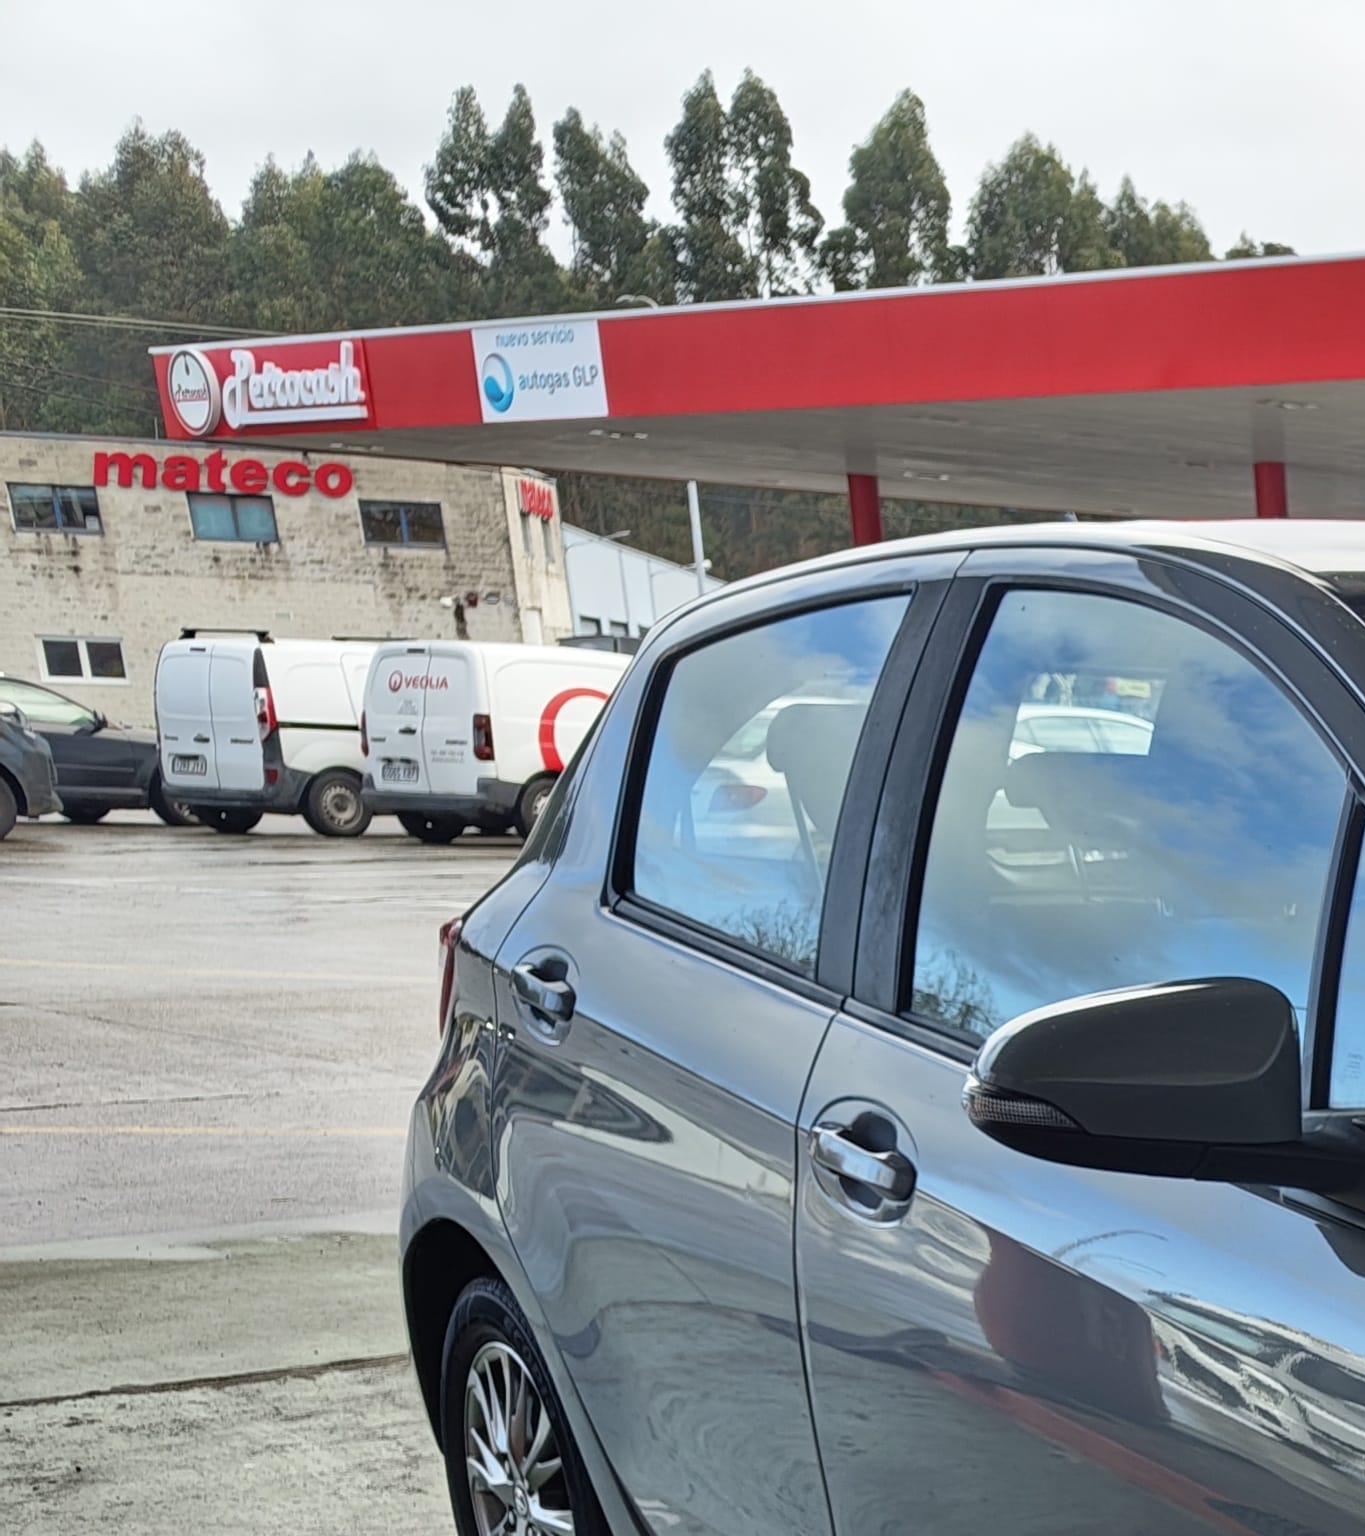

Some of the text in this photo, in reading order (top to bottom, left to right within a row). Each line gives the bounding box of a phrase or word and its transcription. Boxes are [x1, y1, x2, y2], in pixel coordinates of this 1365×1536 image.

[496, 324, 574, 347] nuevo servicio
[518, 364, 598, 395] autogas GLP
[93, 448, 354, 498] mateco
[404, 675, 449, 690] VEOLIA
